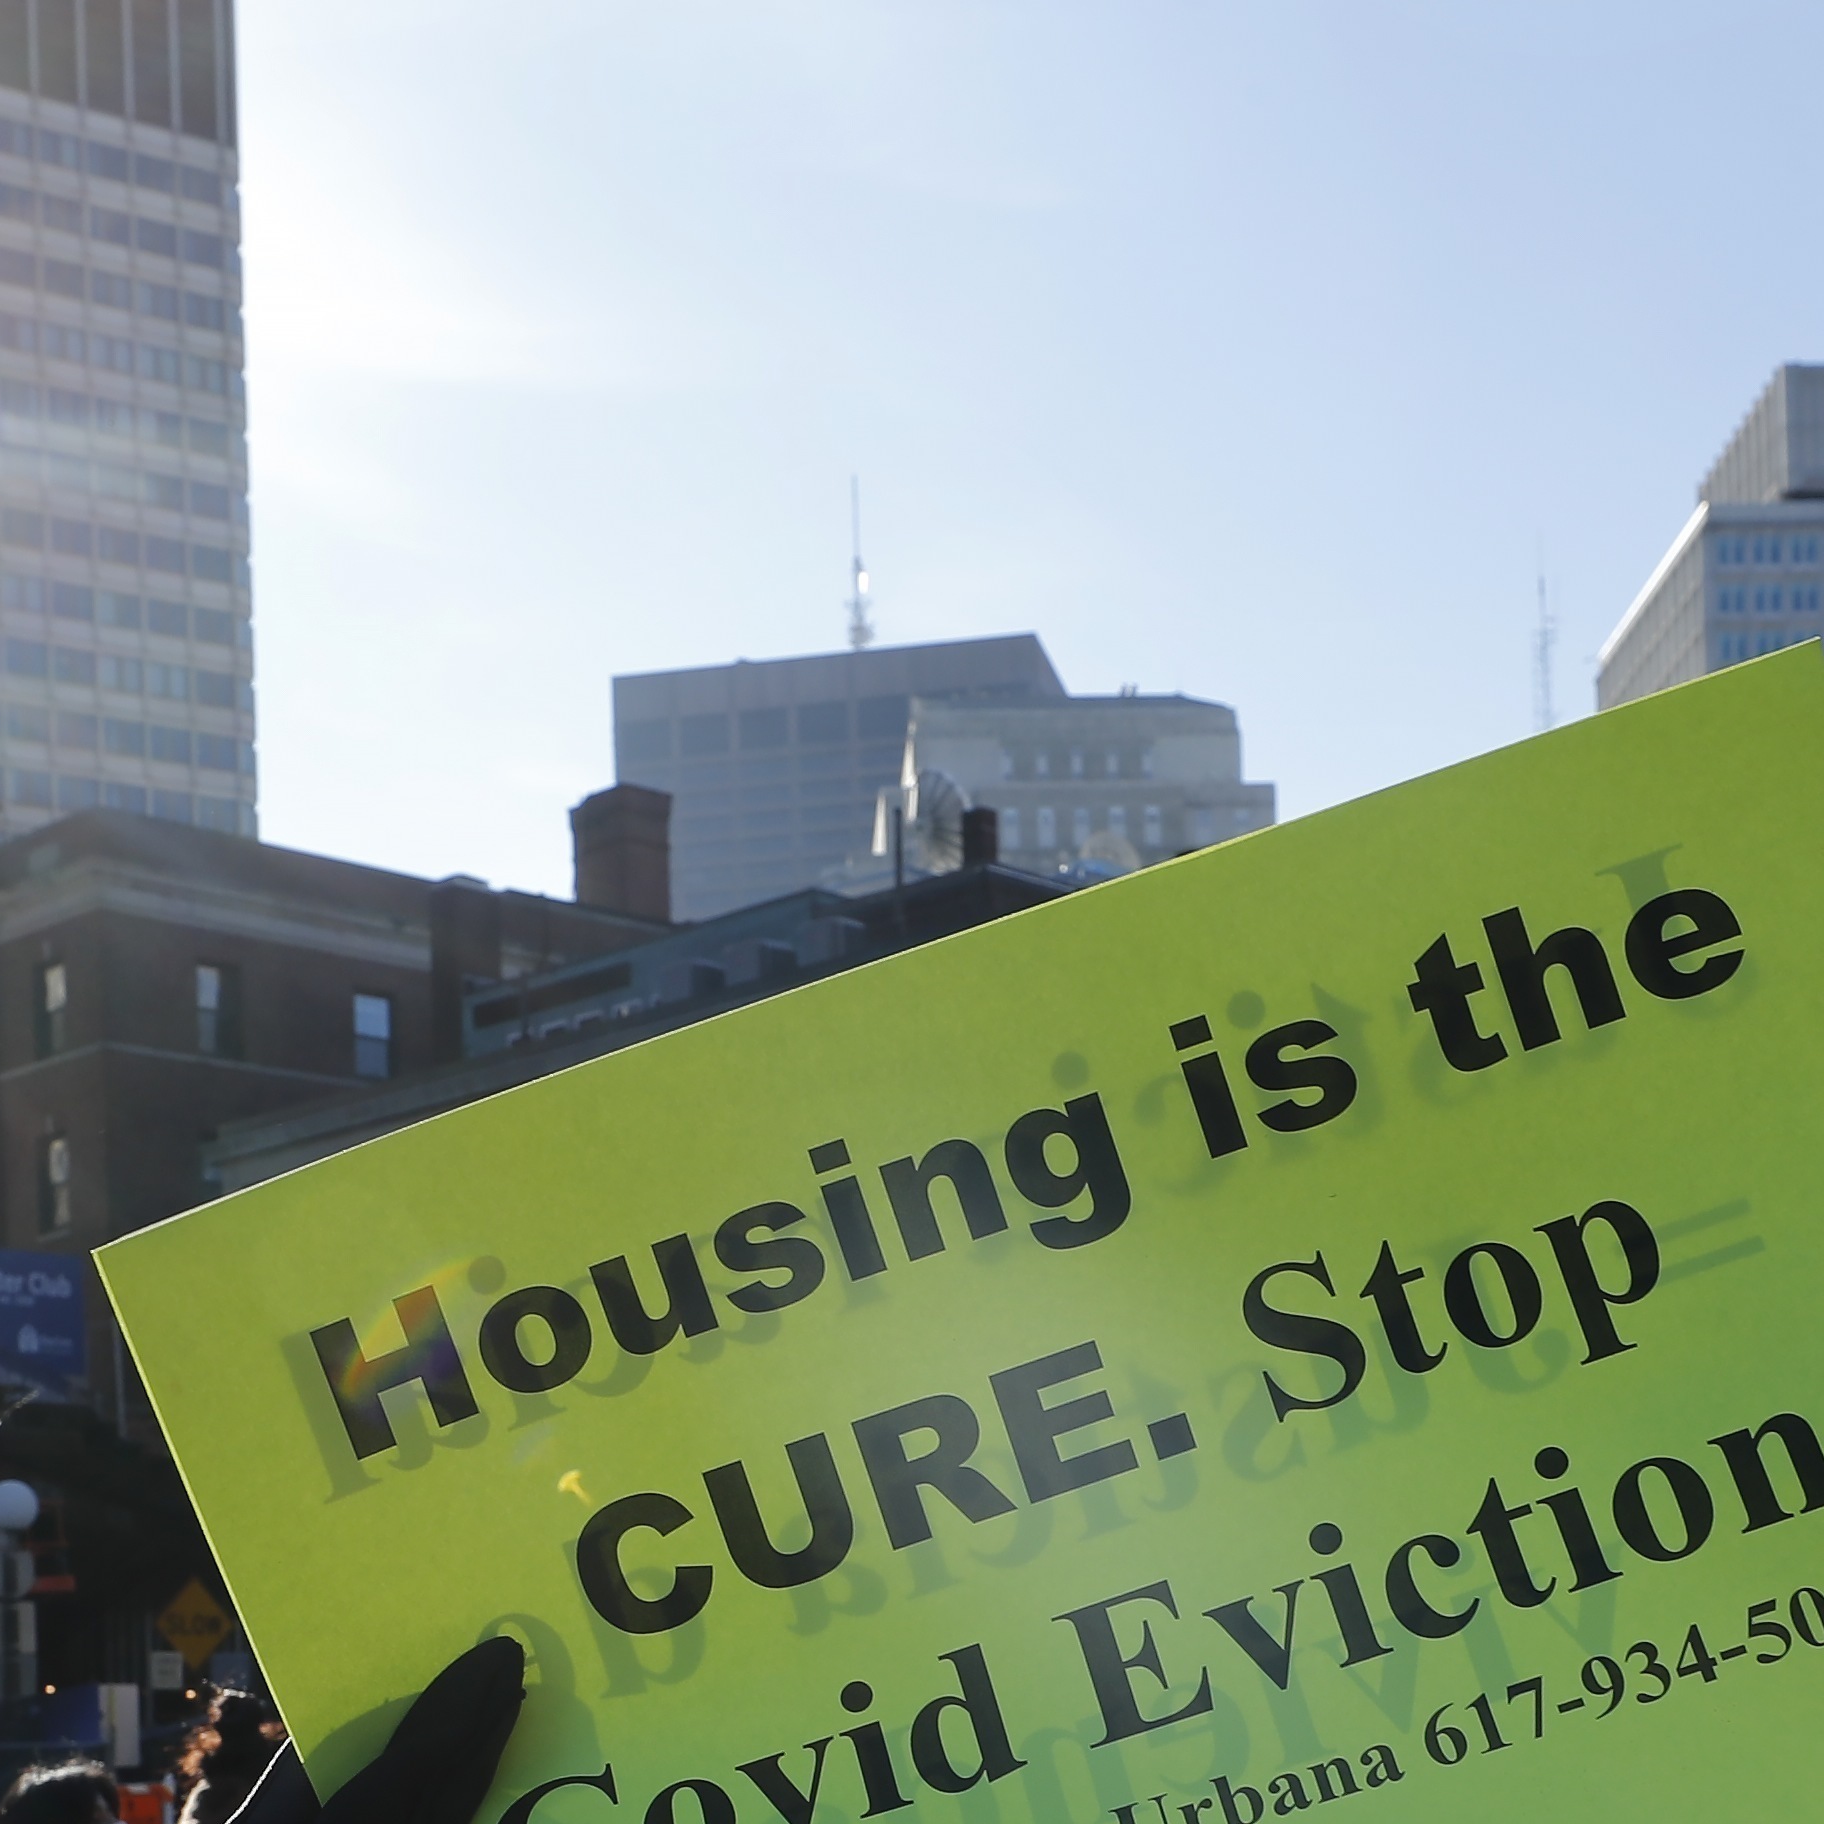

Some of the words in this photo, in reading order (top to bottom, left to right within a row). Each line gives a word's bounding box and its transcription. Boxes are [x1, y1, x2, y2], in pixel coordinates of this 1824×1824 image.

[309, 1092, 1131, 1460] Housing
[1169, 1015, 1357, 1159] is
[1407, 887, 1744, 1072] the
[577, 1338, 1196, 1634] CURE.
[1243, 1201, 1659, 1422] Stop
